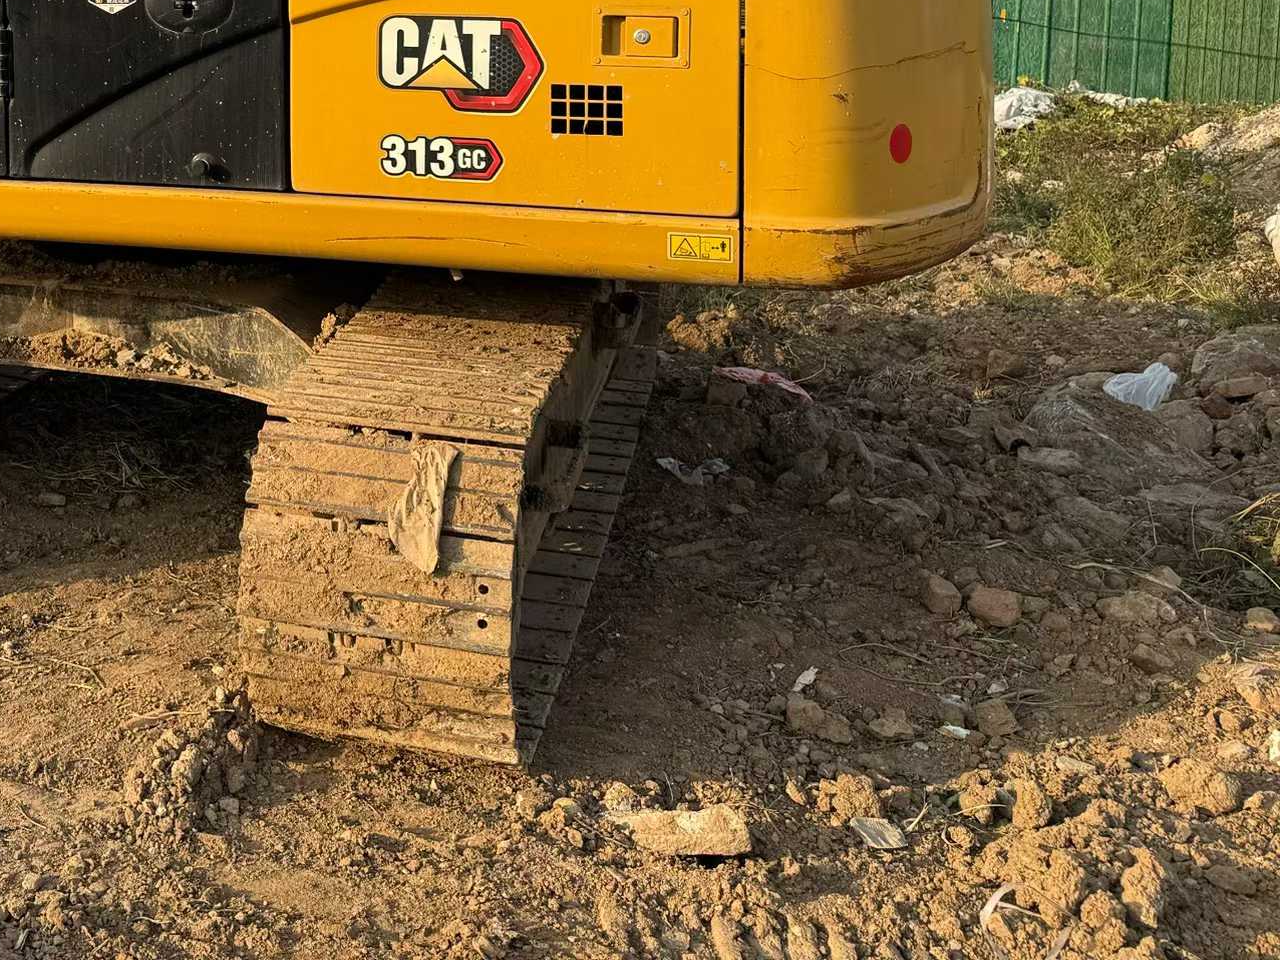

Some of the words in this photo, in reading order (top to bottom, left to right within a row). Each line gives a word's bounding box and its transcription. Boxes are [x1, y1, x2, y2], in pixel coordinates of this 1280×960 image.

[381, 16, 502, 90] CAT
[381, 135, 455, 177] 313
[457, 147, 487, 171] GC
